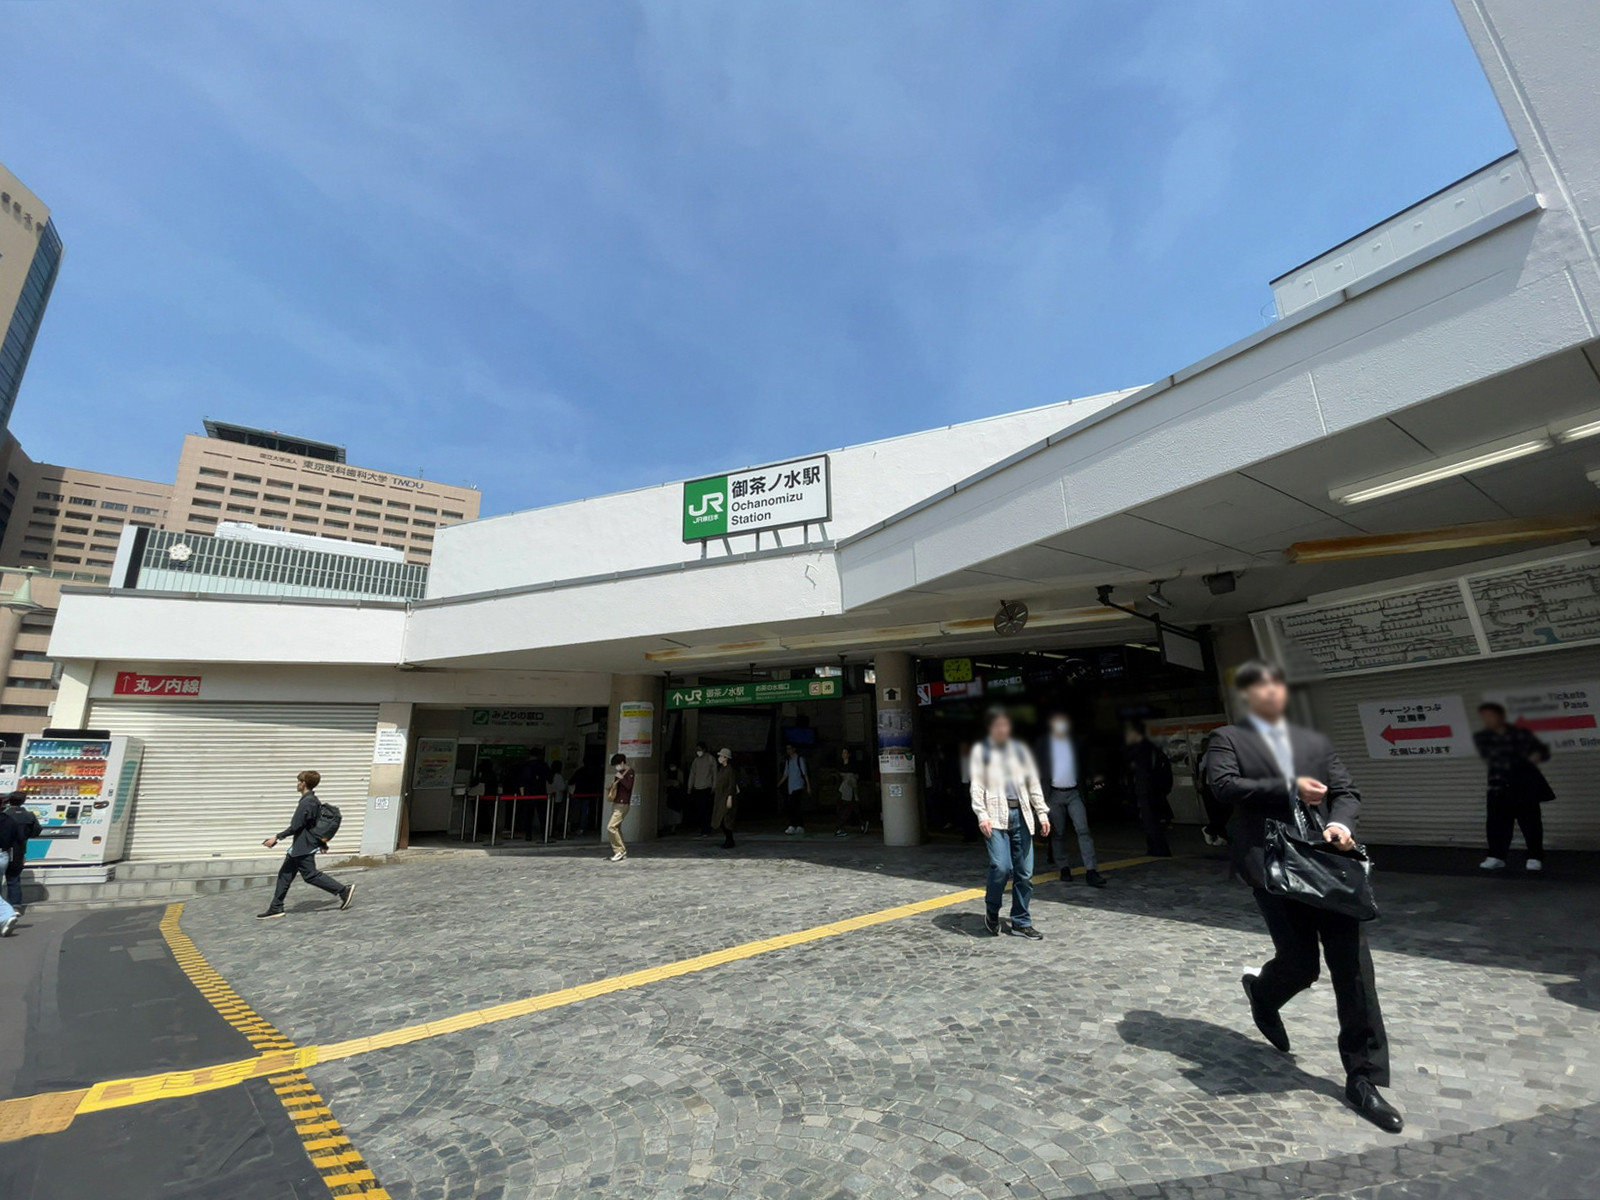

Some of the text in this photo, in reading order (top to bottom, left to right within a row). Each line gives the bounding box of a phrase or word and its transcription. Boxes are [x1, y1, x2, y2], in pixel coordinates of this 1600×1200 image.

[302, 459, 388, 484] 東京医科歯科大学
[391, 477, 424, 489] TMDU
[731, 465, 821, 499] 御茶ノ水駅
[688, 491, 724, 516] JR
[731, 492, 803, 512] Ochanomizu
[731, 512, 771, 526] Station
[133, 677, 200, 693] 丸ノ内線
[706, 686, 745, 698] 御茶ノ水駅
[684, 689, 702, 702] JR
[1563, 700, 1589, 710] Pass
[491, 710, 545, 721] みどりの窓口
